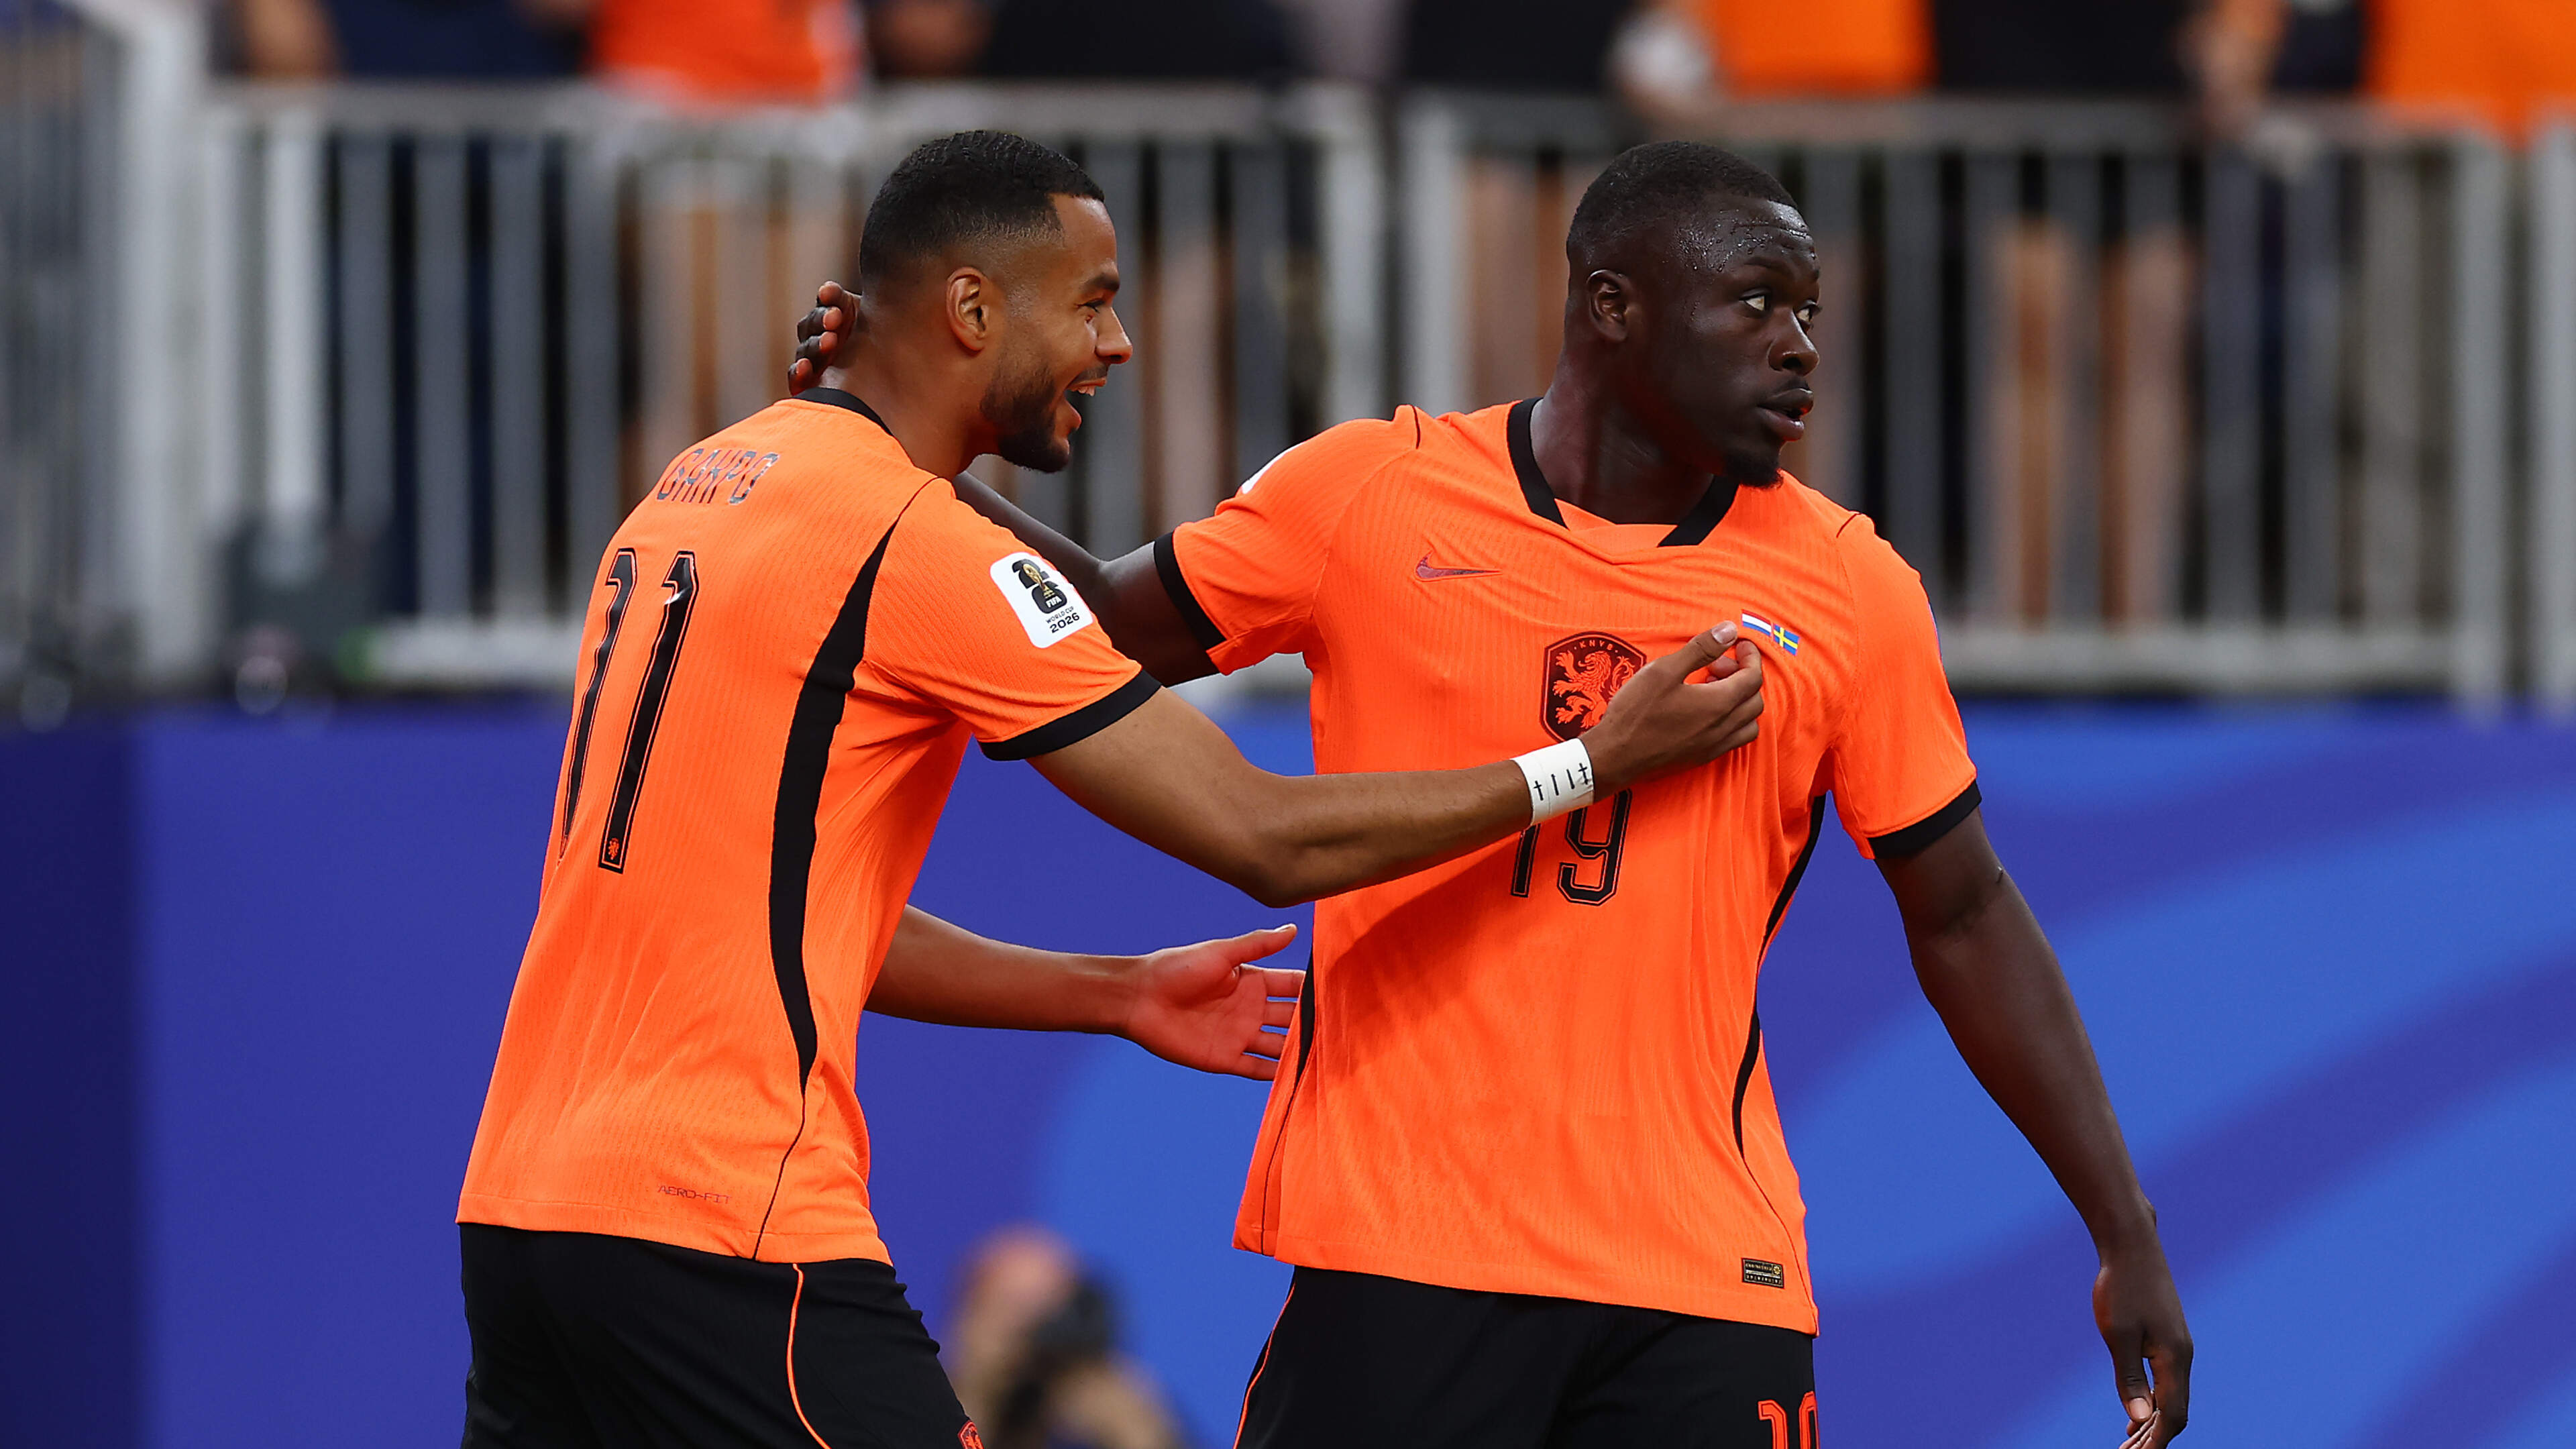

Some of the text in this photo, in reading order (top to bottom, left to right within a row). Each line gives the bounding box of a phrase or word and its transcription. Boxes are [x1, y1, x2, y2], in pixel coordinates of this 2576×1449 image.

[657, 447, 779, 504] GAKPO
[1046, 596, 1063, 608] FIFA
[1046, 606, 1074, 624] WORLD CUP
[1049, 612, 1080, 633] 2026
[559, 547, 699, 874] 11
[657, 1185, 733, 1205] AERO-FIT
